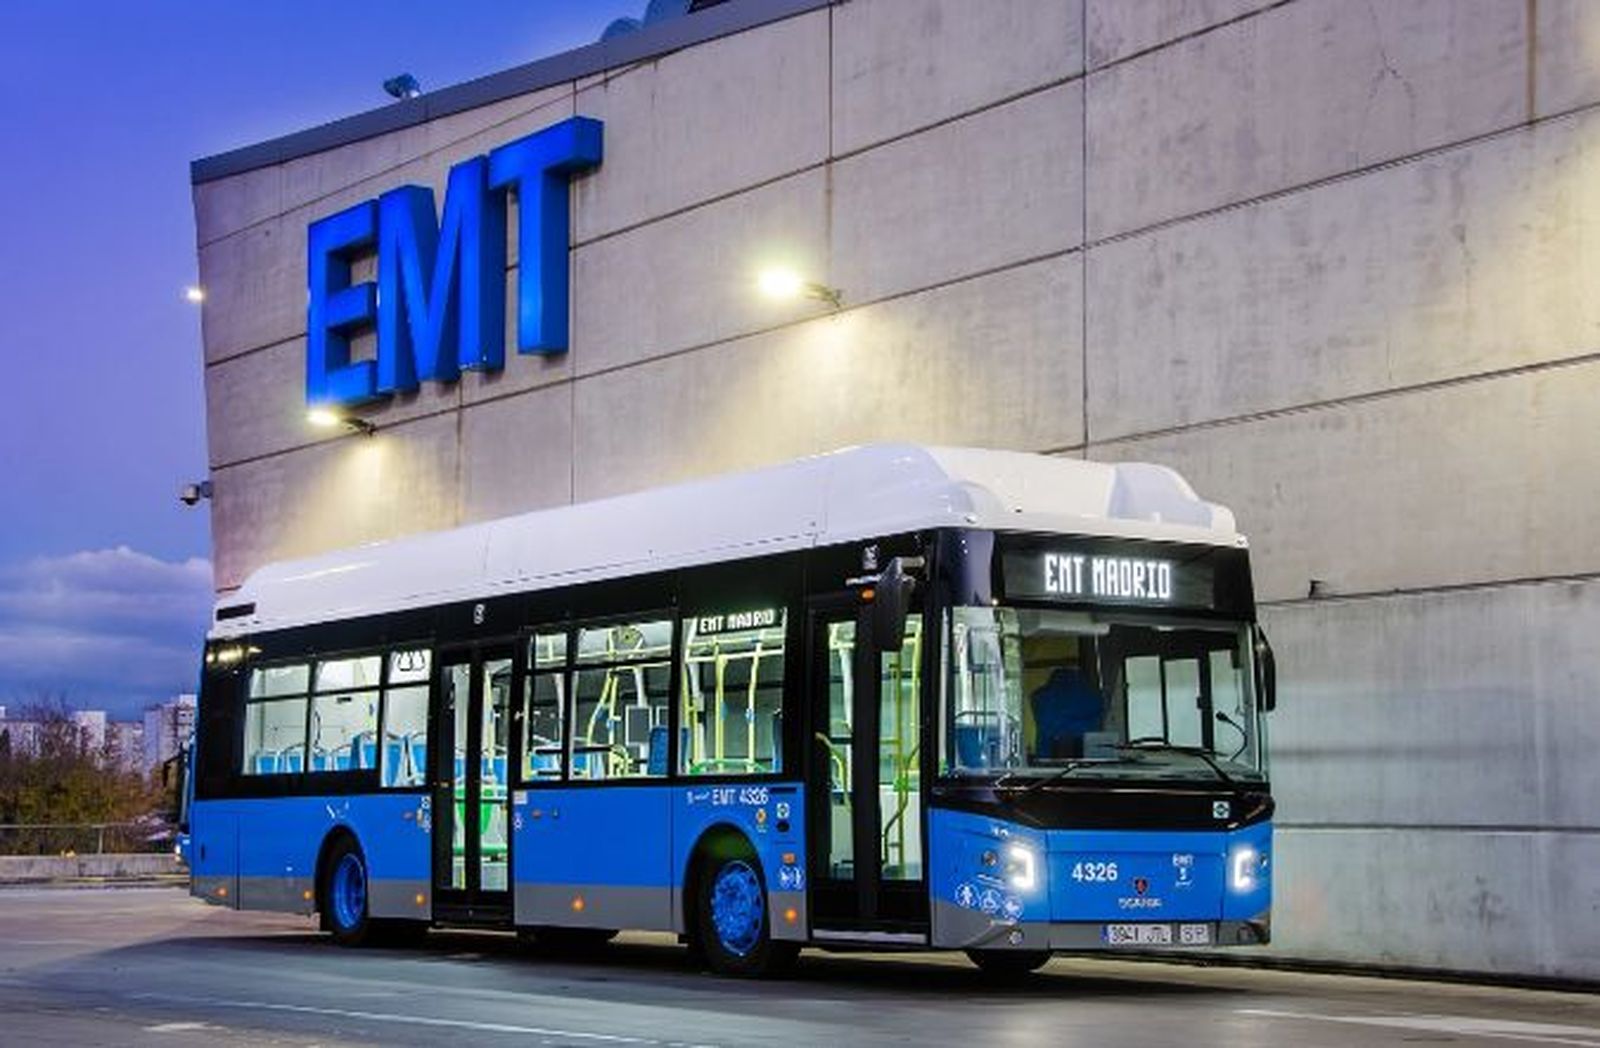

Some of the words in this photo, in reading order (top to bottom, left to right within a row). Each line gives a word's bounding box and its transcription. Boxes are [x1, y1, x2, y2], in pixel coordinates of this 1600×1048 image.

[306, 115, 604, 406] EMT
[1044, 553, 1083, 594] EMT
[1091, 557, 1171, 598] MADRID
[699, 614, 724, 633] EMT
[726, 608, 775, 630] MADRID
[712, 788, 736, 805] EMT
[739, 786, 769, 805] 4326
[1071, 861, 1119, 882] 4326
